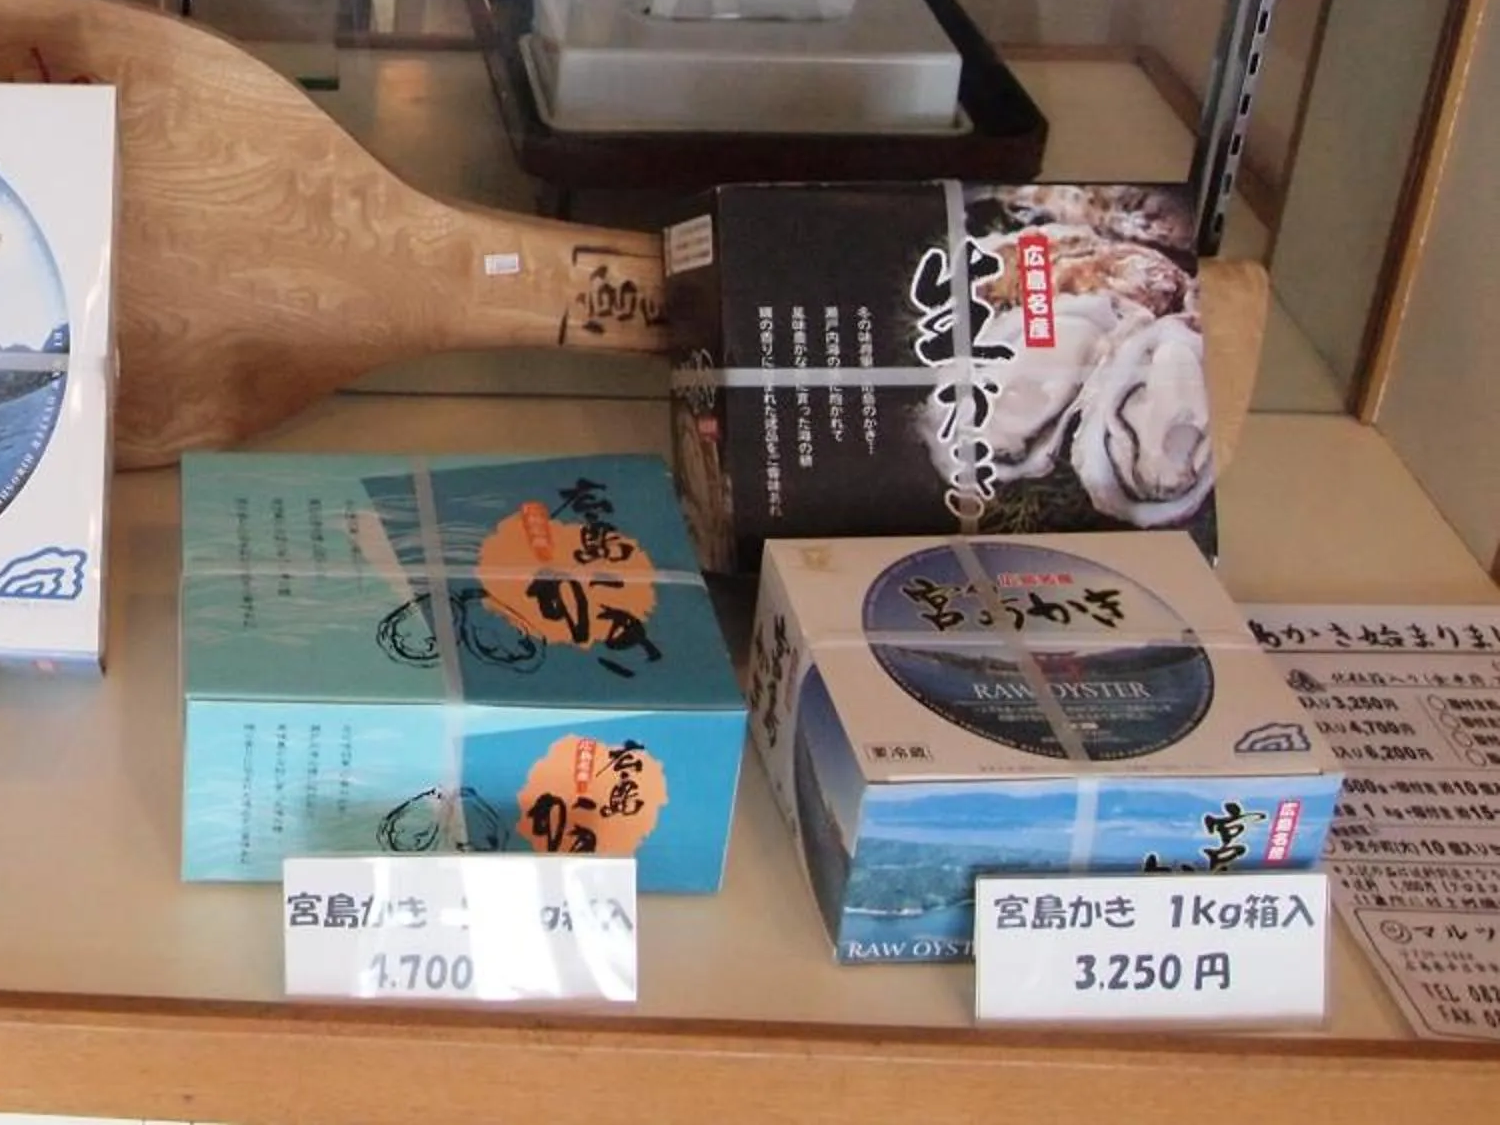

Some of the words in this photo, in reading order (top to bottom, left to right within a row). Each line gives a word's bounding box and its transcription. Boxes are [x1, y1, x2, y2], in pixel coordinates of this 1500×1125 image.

[1023, 244, 1050, 340] 広島名産
[994, 893, 1136, 931] 宮島かき
[848, 941, 906, 958] RAW
